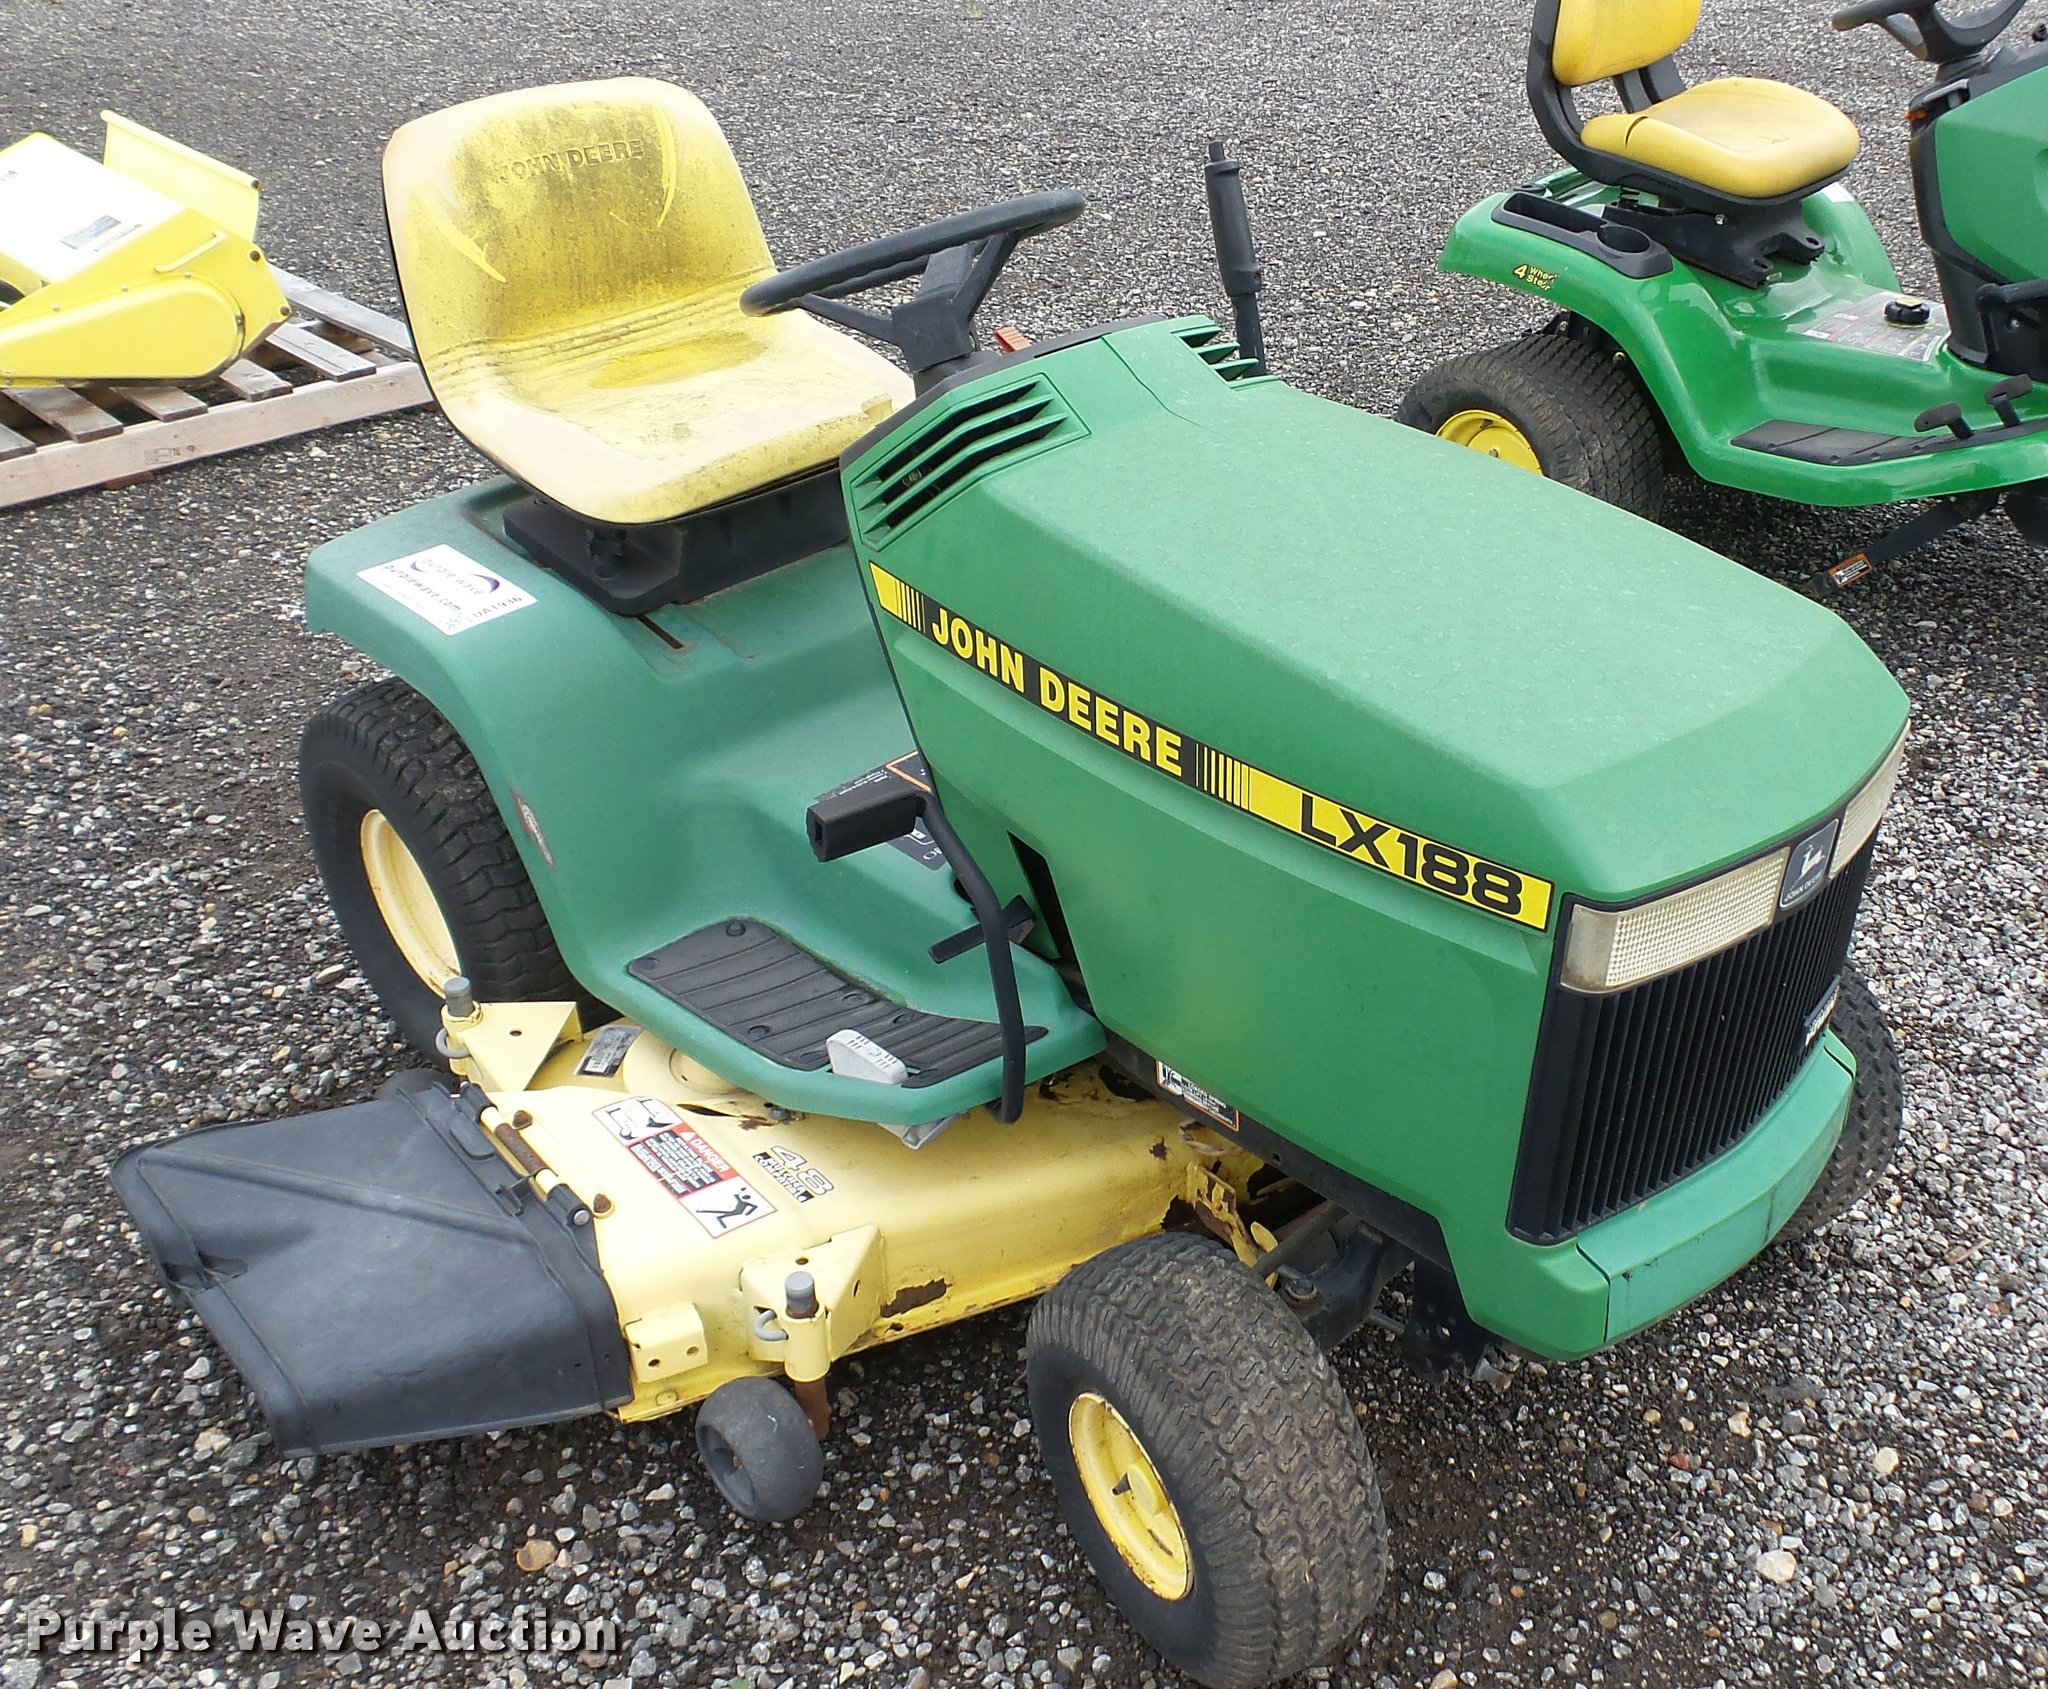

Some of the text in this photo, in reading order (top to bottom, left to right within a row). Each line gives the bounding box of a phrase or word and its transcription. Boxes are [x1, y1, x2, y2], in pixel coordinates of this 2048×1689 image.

[499, 139, 645, 183] JOHN DEERE
[1512, 263, 1529, 280] 4
[383, 563, 462, 613] purplewave.com
[932, 608, 1183, 778] JOHN DEERE
[1300, 792, 1523, 916] LX188
[689, 1138, 732, 1172] DANGER
[770, 1145, 834, 1196] 48
